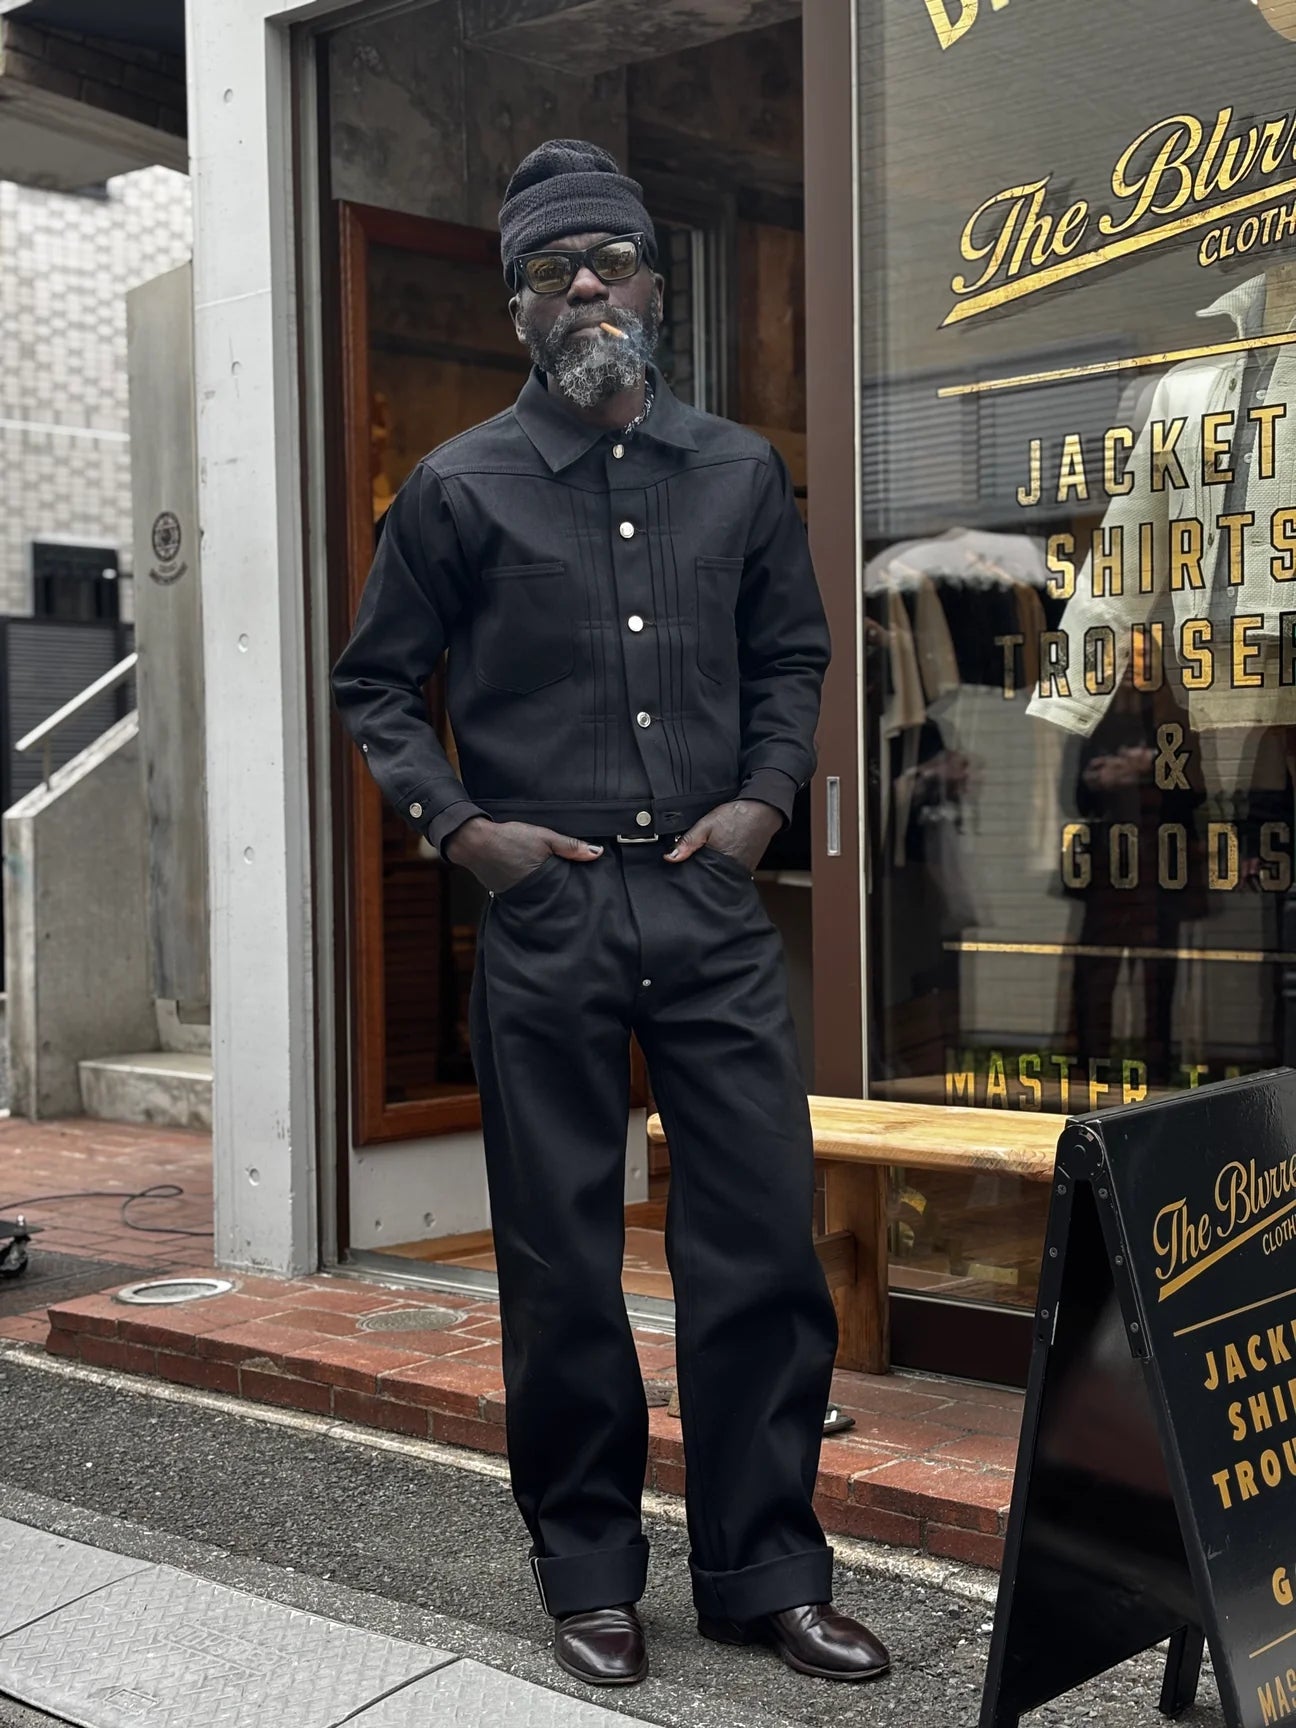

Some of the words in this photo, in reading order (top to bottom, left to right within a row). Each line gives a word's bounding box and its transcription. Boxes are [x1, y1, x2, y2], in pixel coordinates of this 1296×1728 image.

[951, 173, 1088, 294] The
[1199, 202, 1296, 266] CLOTH
[1017, 403, 1286, 507] JACKET
[1046, 507, 1296, 600] SHIRTS
[1155, 723, 1192, 790] &
[1061, 822, 1293, 891] GOODS
[945, 1049, 1148, 1113] MASTER
[1153, 1197, 1212, 1279] The
[1204, 1319, 1296, 1391] JACK
